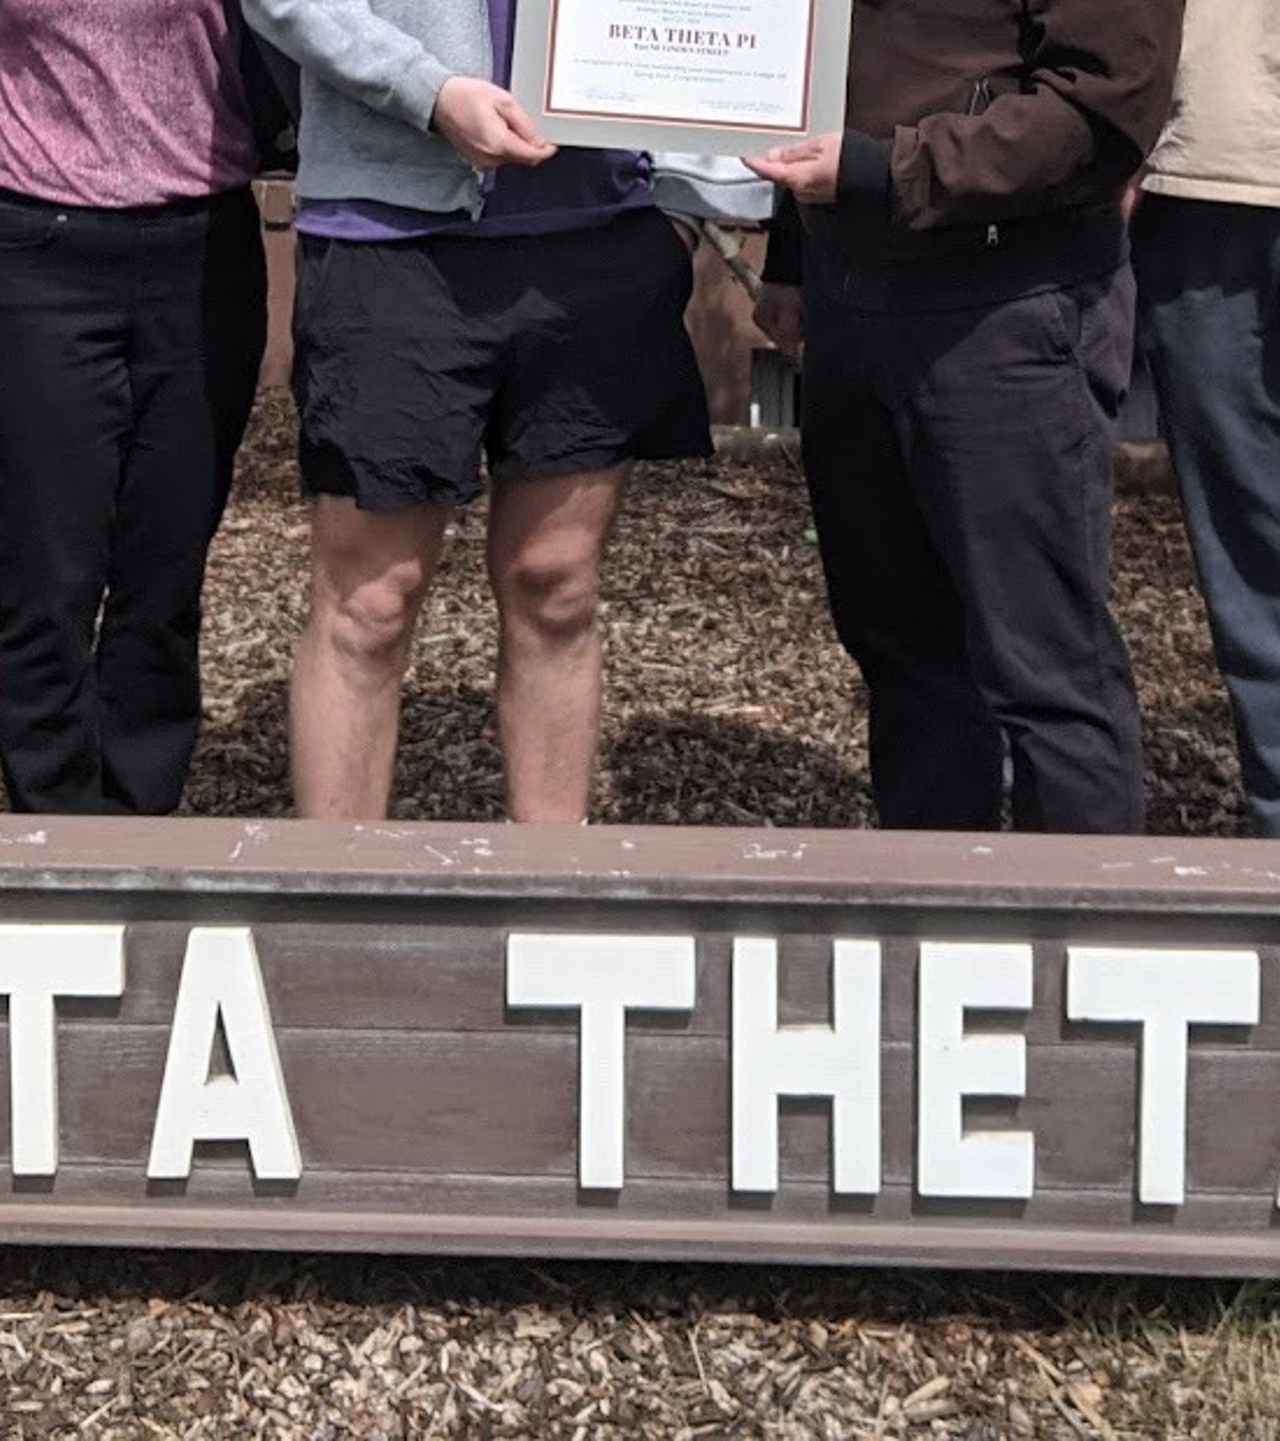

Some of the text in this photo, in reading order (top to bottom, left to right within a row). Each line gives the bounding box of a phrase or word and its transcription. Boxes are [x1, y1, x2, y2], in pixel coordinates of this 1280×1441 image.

[608, 23, 659, 42] BETA
[664, 27, 731, 48] THETA
[736, 32, 757, 49] PI
